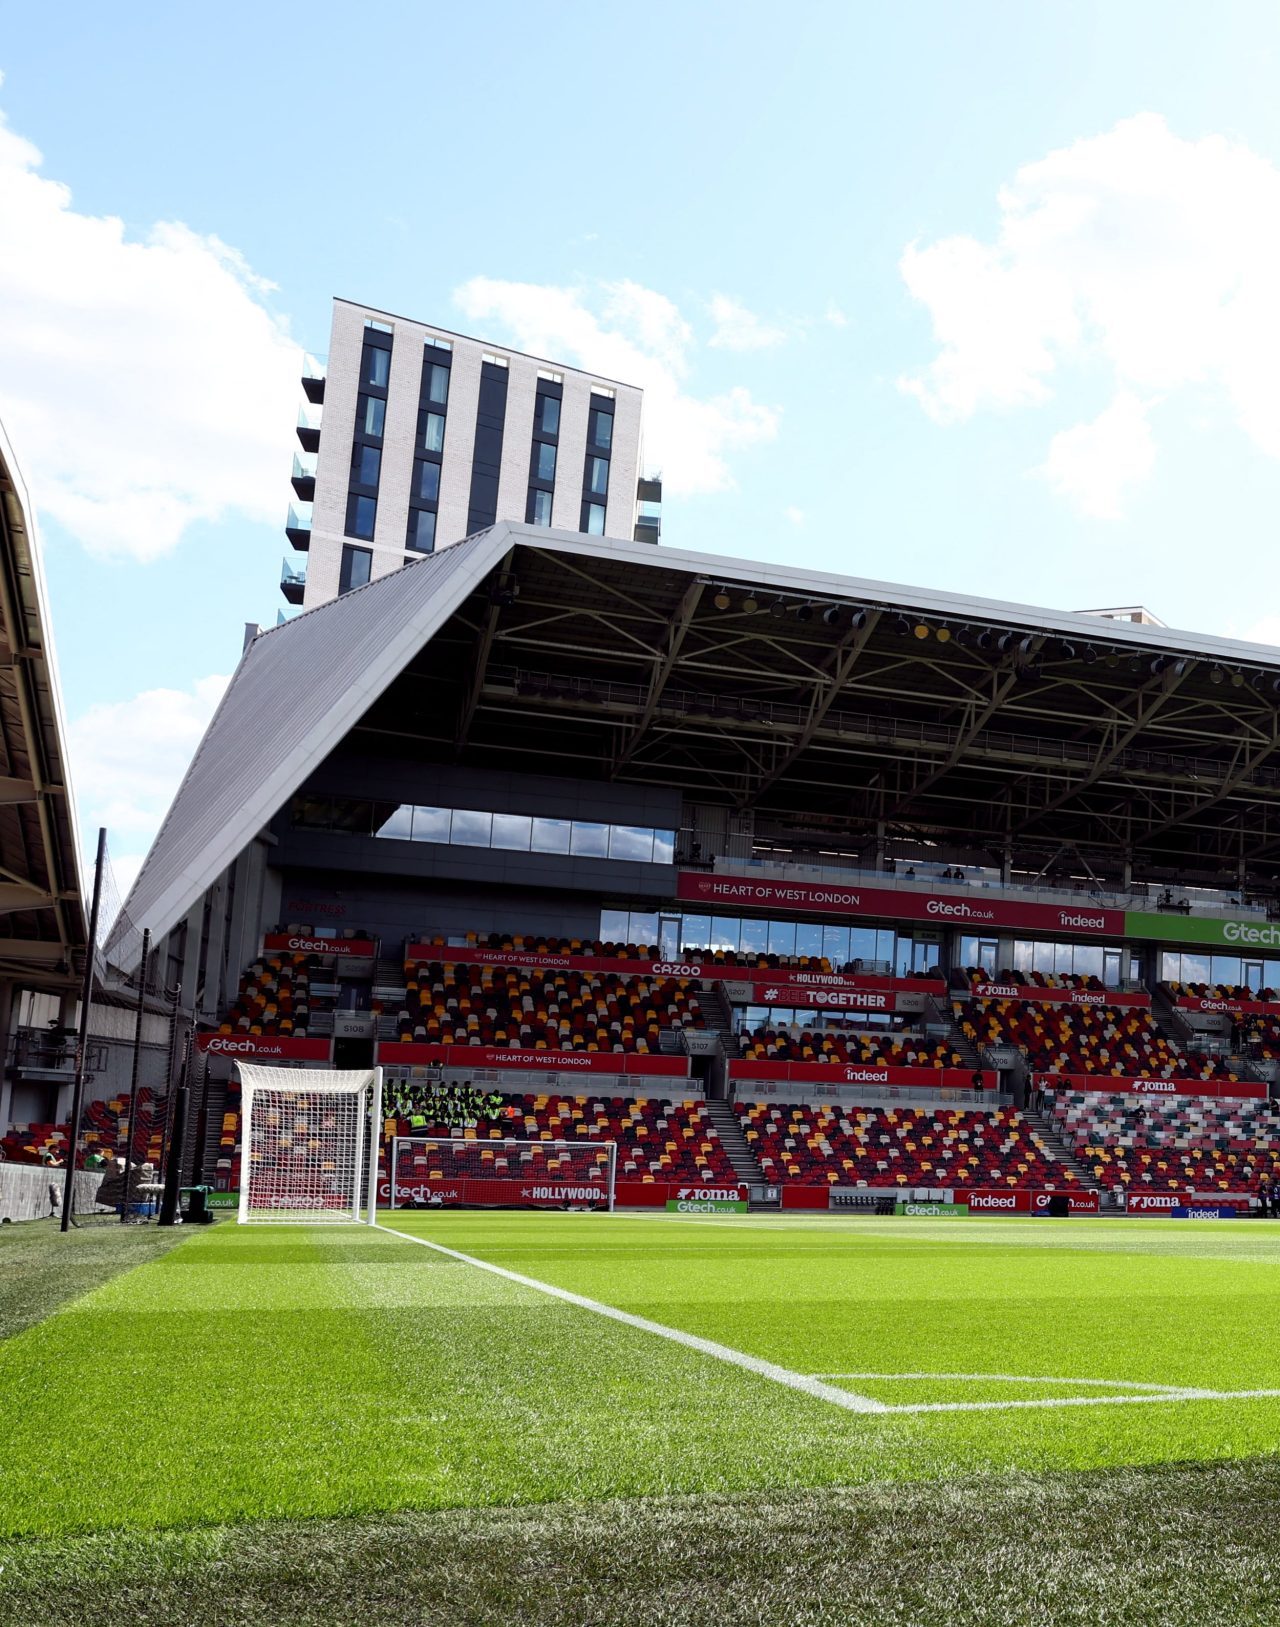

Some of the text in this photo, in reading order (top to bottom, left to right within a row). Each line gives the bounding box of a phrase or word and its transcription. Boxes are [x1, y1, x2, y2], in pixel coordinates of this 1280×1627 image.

[714, 884, 754, 896] HEART
[756, 887, 772, 898] OF
[774, 888, 806, 900] WEST
[809, 892, 860, 904] LONDON
[926, 900, 994, 919] Gtech.co.uk
[1058, 911, 1104, 928] indeed
[288, 938, 350, 953] Gtech.co.uk
[483, 953, 506, 961] HEART
[508, 954, 518, 962] OF
[519, 956, 538, 964] WEST
[539, 957, 570, 966] LONDON
[1071, 991, 1105, 1004] indeed
[1200, 1000, 1242, 1011] Gtech.co.uk
[209, 1038, 282, 1054] Gtech.co.uk
[496, 1054, 522, 1062] HEART
[523, 1055, 534, 1063] OF
[535, 1056, 556, 1064] WEST
[558, 1056, 592, 1065] LONDON
[844, 1067, 888, 1082] indeed
[968, 1192, 1016, 1208] indeed
[678, 1201, 736, 1214] Gtech.co.uk
[906, 1204, 958, 1216] Gtech.co.uk
[1186, 1208, 1219, 1218] indeed
